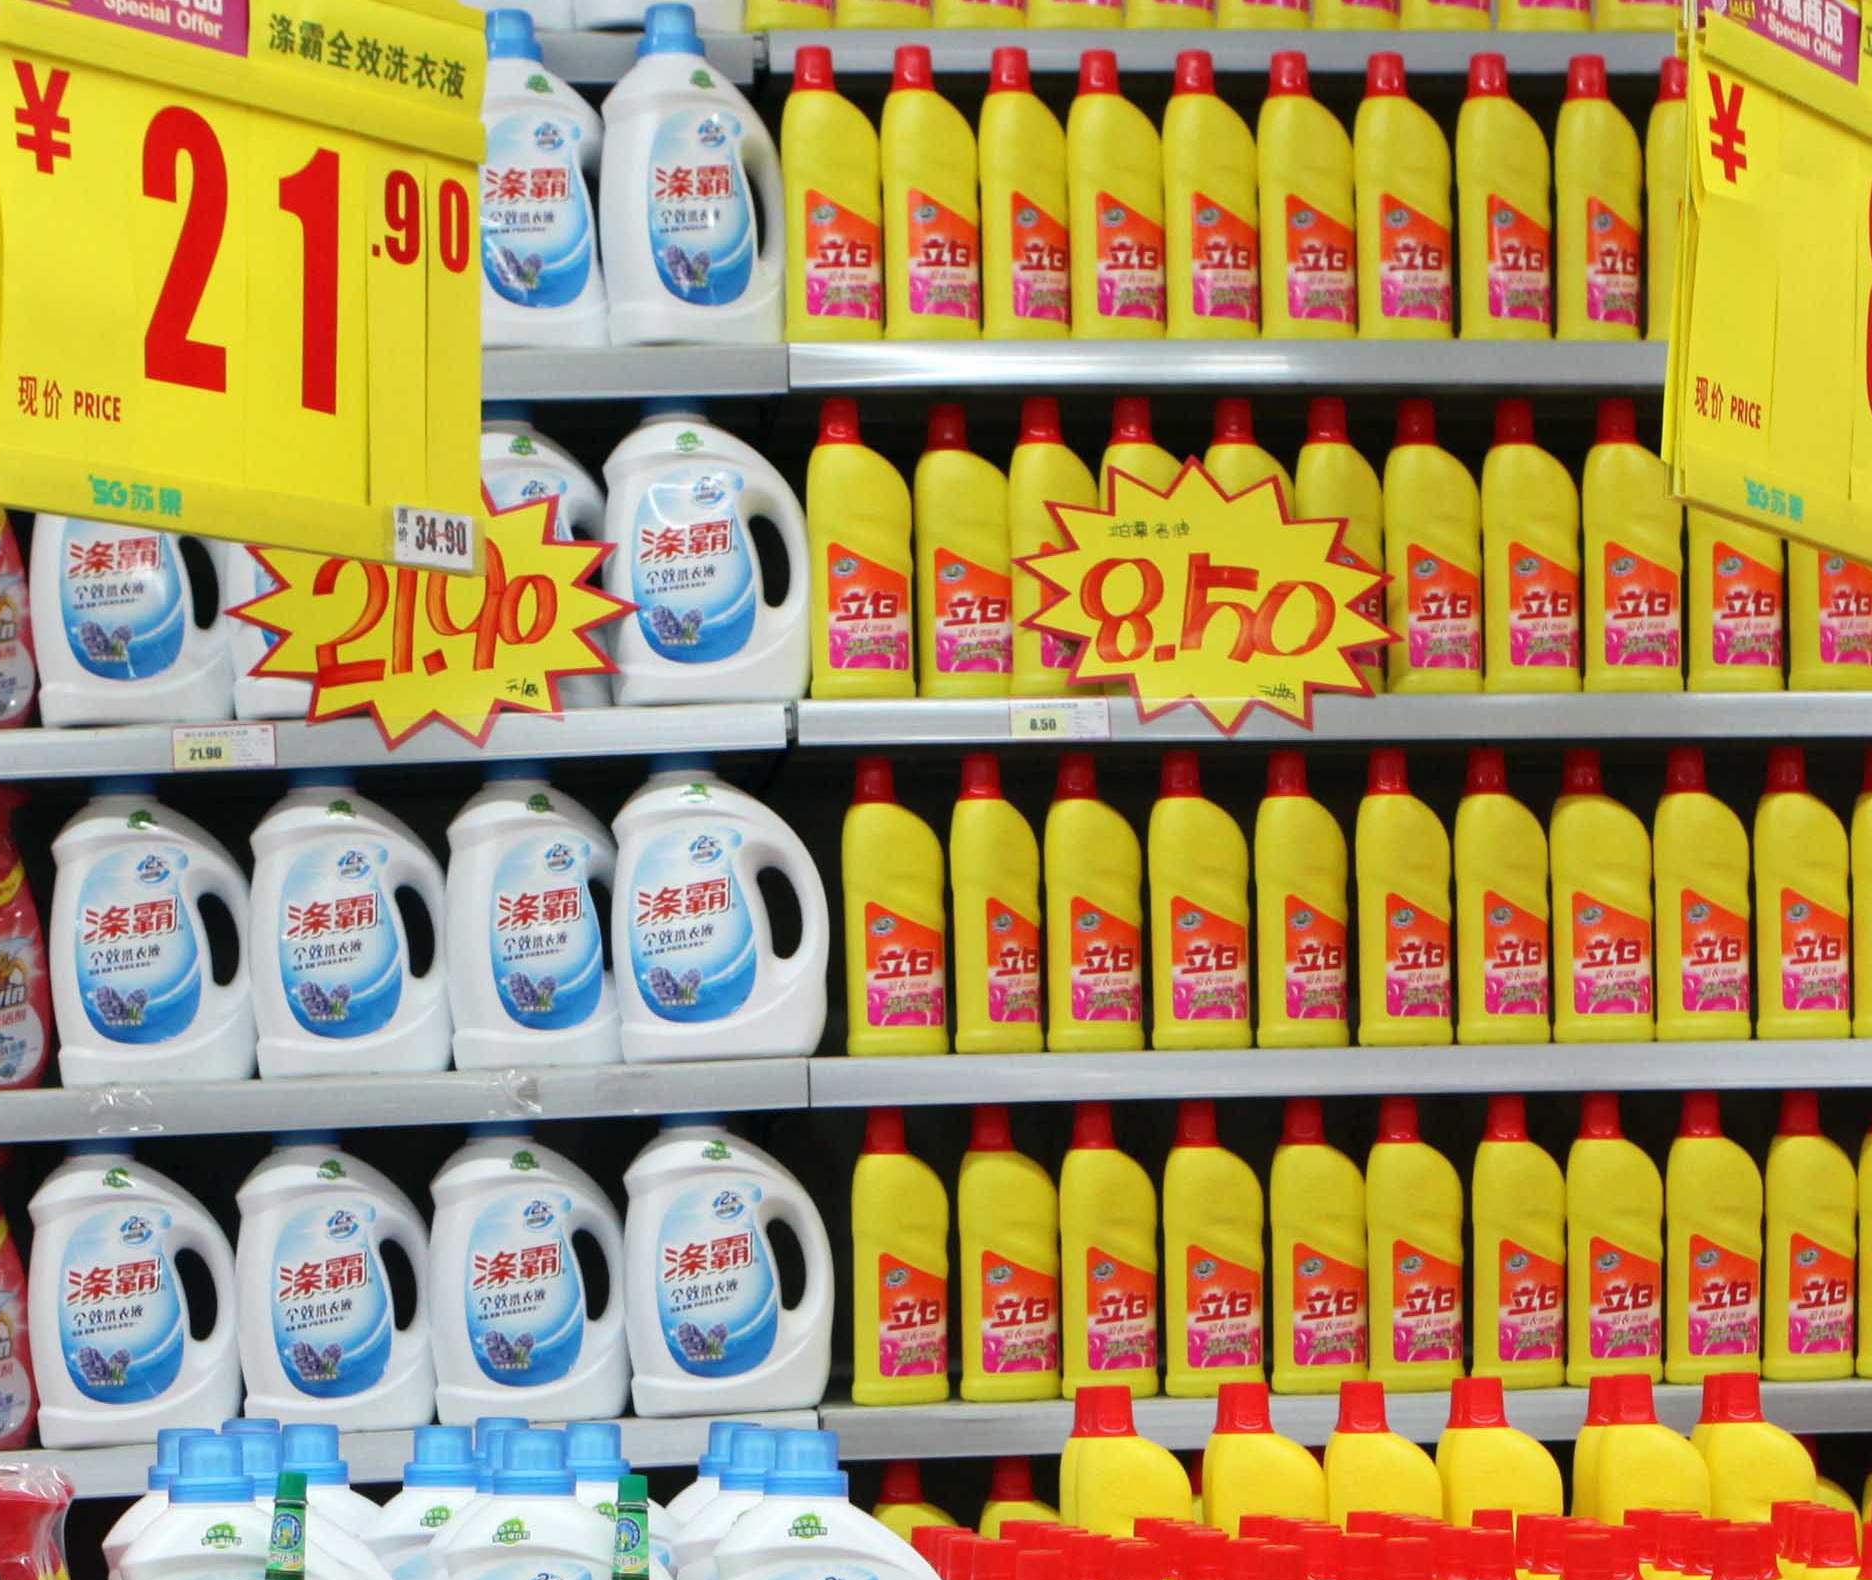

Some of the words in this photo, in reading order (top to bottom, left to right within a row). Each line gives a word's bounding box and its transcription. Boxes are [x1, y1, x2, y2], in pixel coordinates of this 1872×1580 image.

[177, 11, 223, 40] Offer
[1767, 14, 1810, 50] Special
[1813, 36, 1844, 68] Offer
[269, 13, 466, 100] 涤霸全效洗衣液
[17, 375, 63, 422] 现价
[73, 390, 122, 424] PRICE
[1694, 375, 1725, 425] 现价
[1730, 395, 1762, 431] PRICE
[415, 515, 468, 557] 34.90
[642, 522, 732, 559] 涤霸
[1080, 552, 1337, 663] 8.50
[1029, 717, 1058, 731] 8.50
[188, 746, 223, 762] 21.90
[85, 895, 177, 937] 涤霸
[638, 880, 726, 920] 涤霸
[1583, 938, 1642, 968] 立白
[664, 1235, 753, 1275] 涤霸
[68, 1260, 160, 1300] 涤霸
